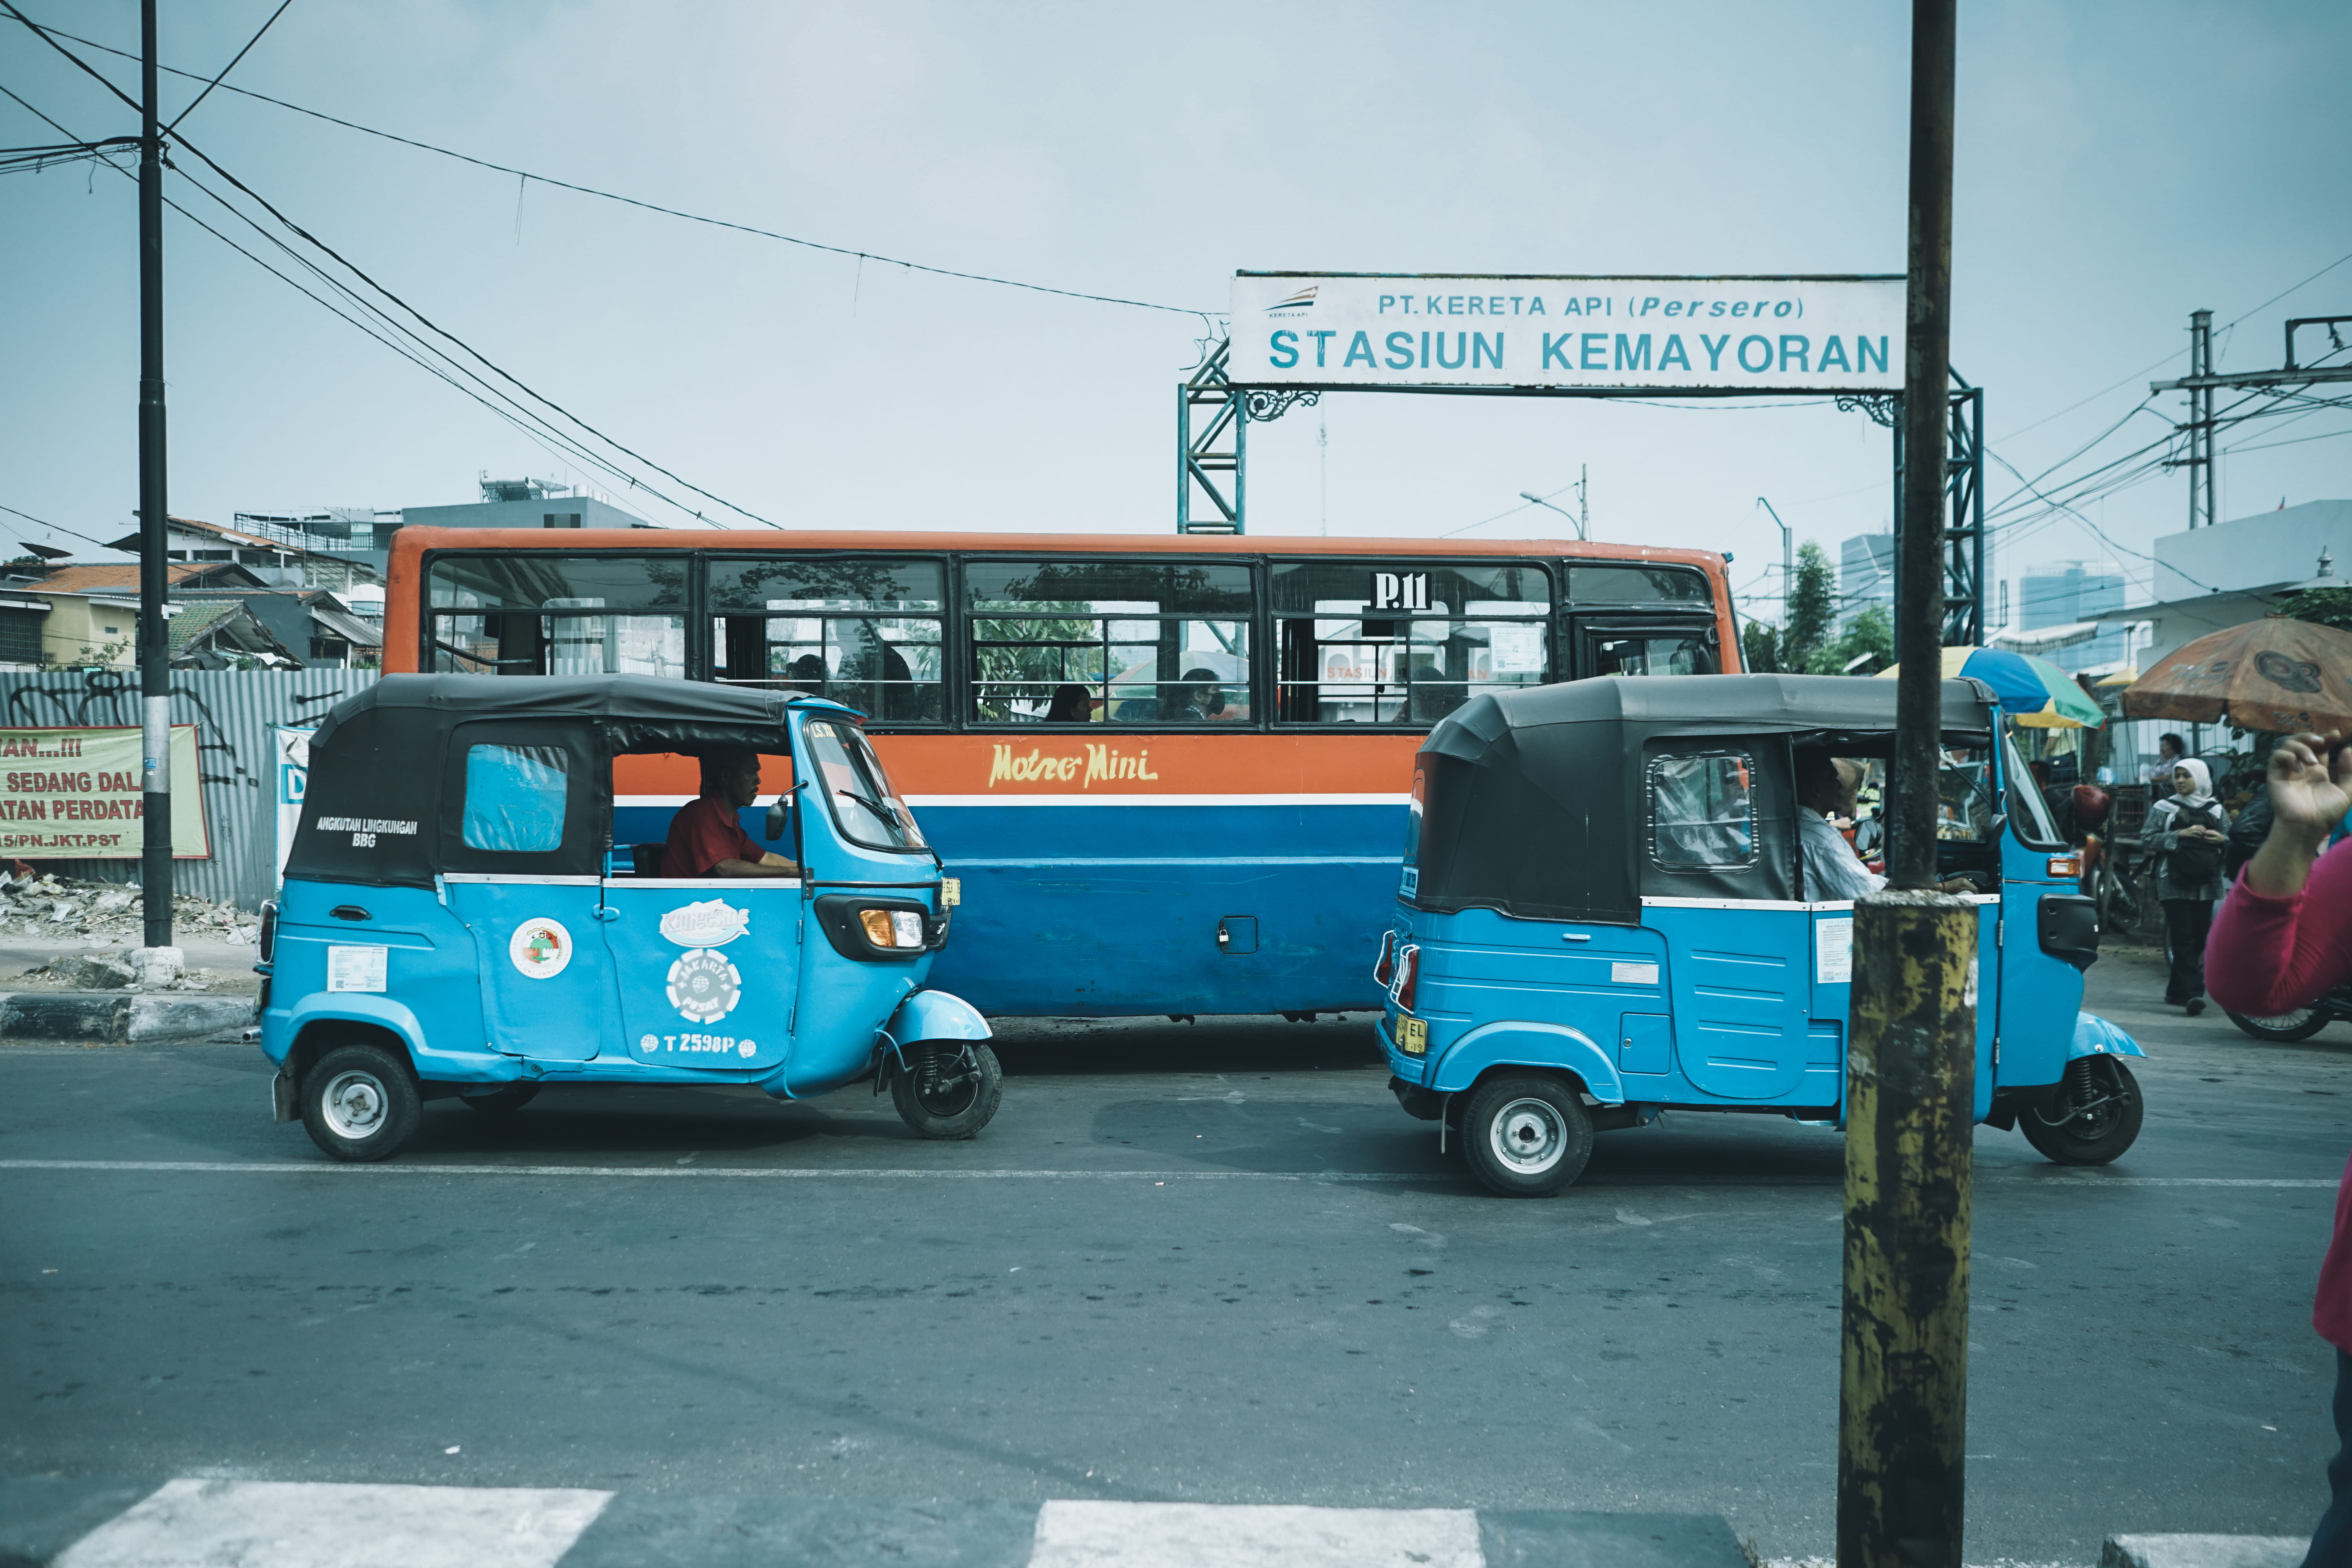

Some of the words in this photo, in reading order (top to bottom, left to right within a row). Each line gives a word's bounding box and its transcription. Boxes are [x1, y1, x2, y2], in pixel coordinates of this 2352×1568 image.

[1564, 297, 1612, 316] API
[1629, 296, 1803, 319] (Persero)
[1268, 330, 1505, 370] STASIUN
[1541, 332, 1890, 374] KEMAYORAN
[1375, 573, 1427, 610] P.11
[0, 738, 82, 757] AN...!!!
[1084, 744, 1159, 788] Mini
[7, 772, 92, 793] SEDANG
[98, 772, 144, 792] DAL
[53, 800, 144, 820] PERDATA
[316, 816, 362, 832] ANGKUTAN
[362, 818, 418, 835] LINGKUNGAN
[352, 833, 377, 848] BBG
[680, 959, 728, 981] JAKARTA
[682, 996, 720, 1013] PUSAT
[1411, 1023, 1423, 1037] EL
[663, 1036, 677, 1052] T
[679, 1033, 735, 1053] 2598P
